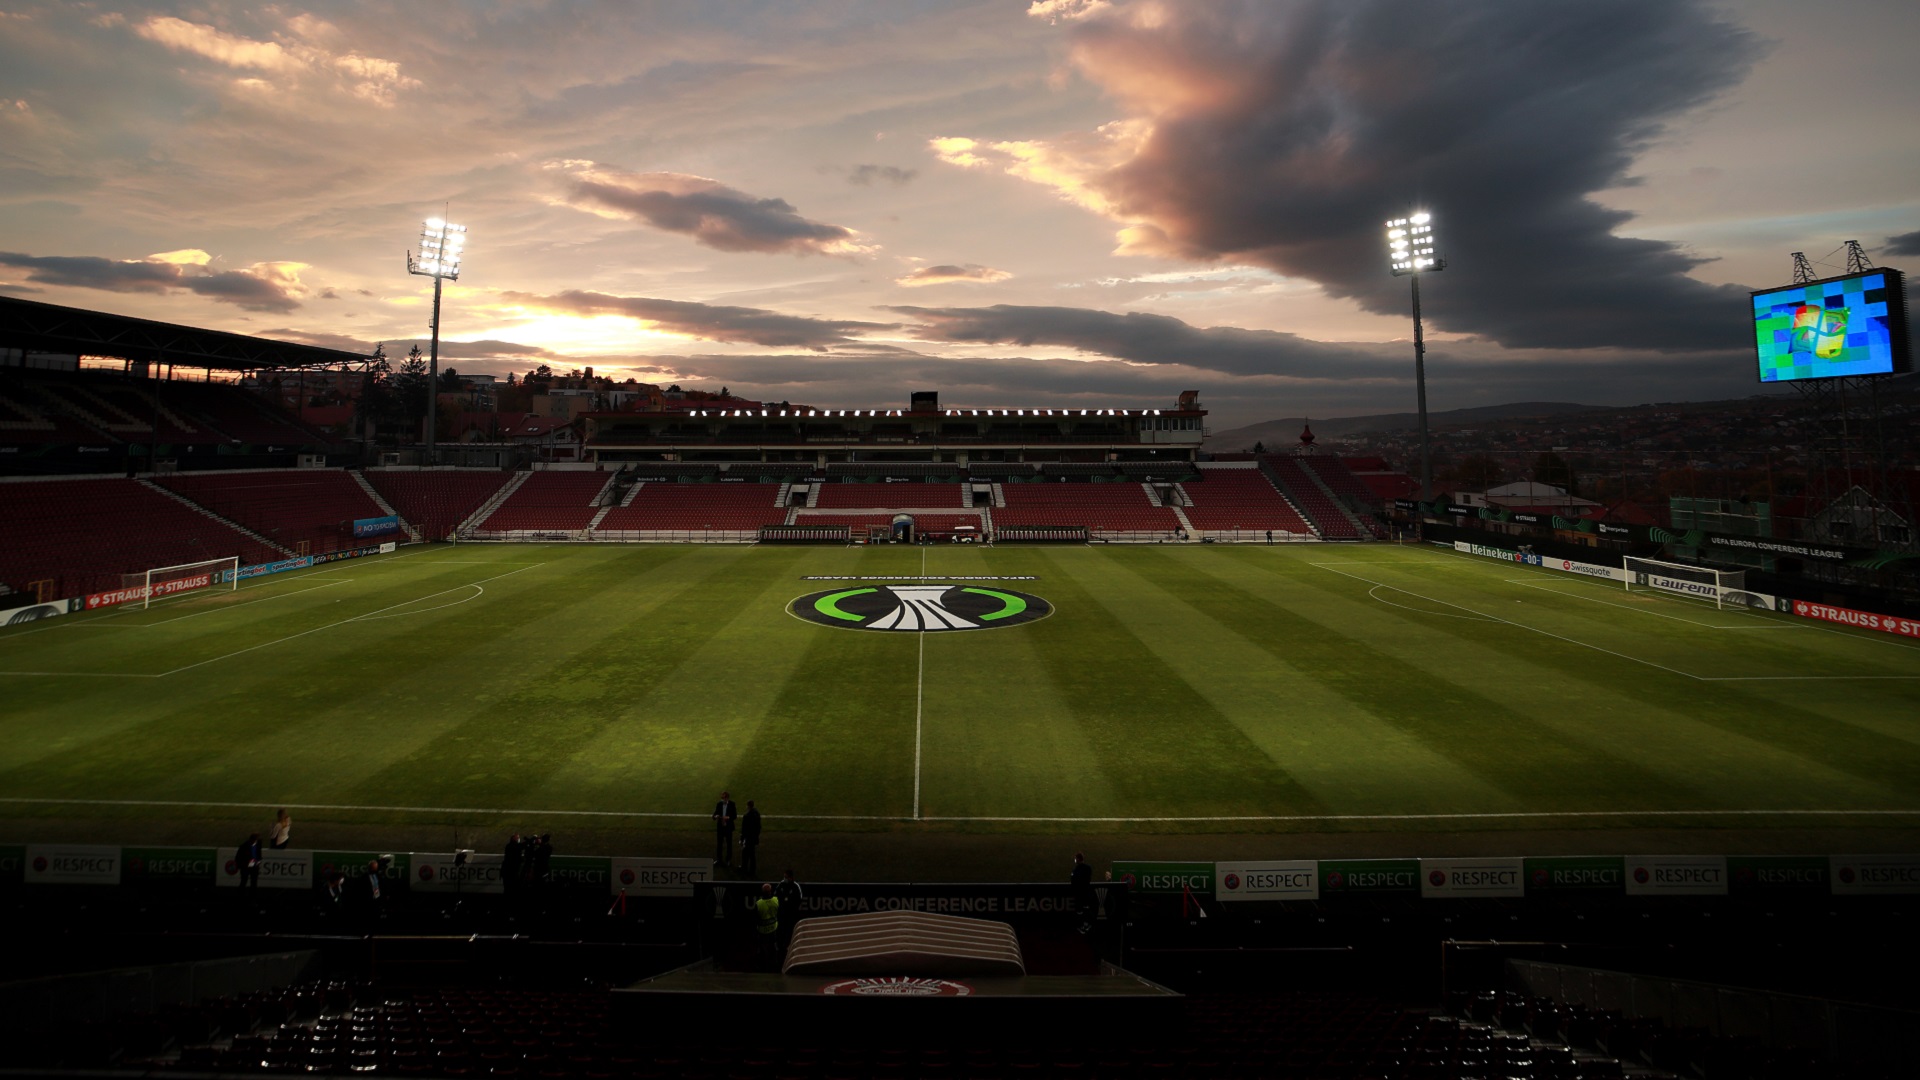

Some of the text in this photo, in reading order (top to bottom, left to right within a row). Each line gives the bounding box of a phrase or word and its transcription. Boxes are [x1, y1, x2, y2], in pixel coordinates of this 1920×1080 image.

[1472, 543, 1514, 561] Heineken
[1711, 537, 1844, 559] UEFA EUROPA CONFERENCE LEAGUE
[1571, 562, 1611, 576] Swissquote
[165, 575, 208, 593] STRAUSS
[1811, 605, 1879, 628] STRAUSS
[53, 857, 114, 872] RESPECT
[148, 859, 212, 874] RESPECT
[258, 862, 306, 877] ESPECT
[641, 871, 707, 884] RESPECT
[1142, 875, 1209, 889] RESPECT
[1247, 874, 1312, 888] RESPECT
[1350, 872, 1415, 886] RESPECT
[1452, 872, 1517, 885] RESPECT
[1554, 869, 1619, 883] RESPECT
[1655, 868, 1720, 882] RESPECT
[1757, 868, 1825, 882] RESPECT
[799, 896, 1076, 912] EUROPA CONFERENCE LEAGUE
